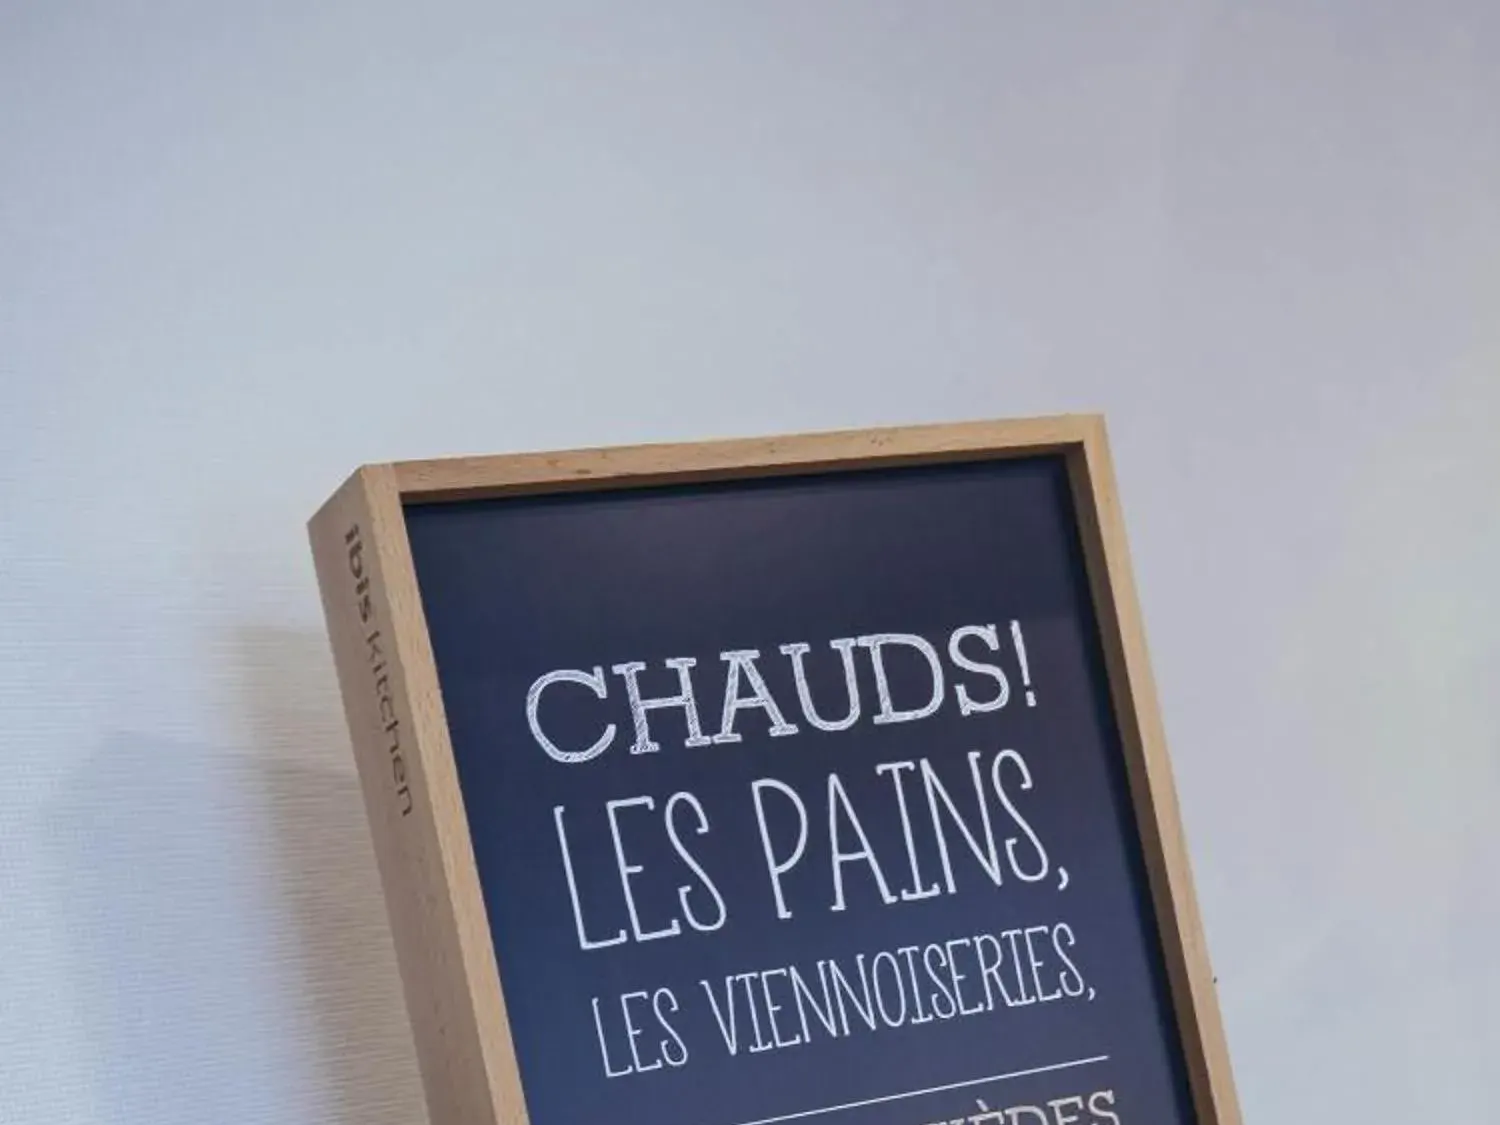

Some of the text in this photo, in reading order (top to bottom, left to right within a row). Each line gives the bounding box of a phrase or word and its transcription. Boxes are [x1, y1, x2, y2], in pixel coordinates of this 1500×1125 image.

[343, 523, 414, 818] ibis kitchen
[525, 619, 1038, 764] CHAUDS!
[552, 748, 1071, 952] LES PAINS,
[591, 922, 1097, 1079] LES VIENNOISERIES,
